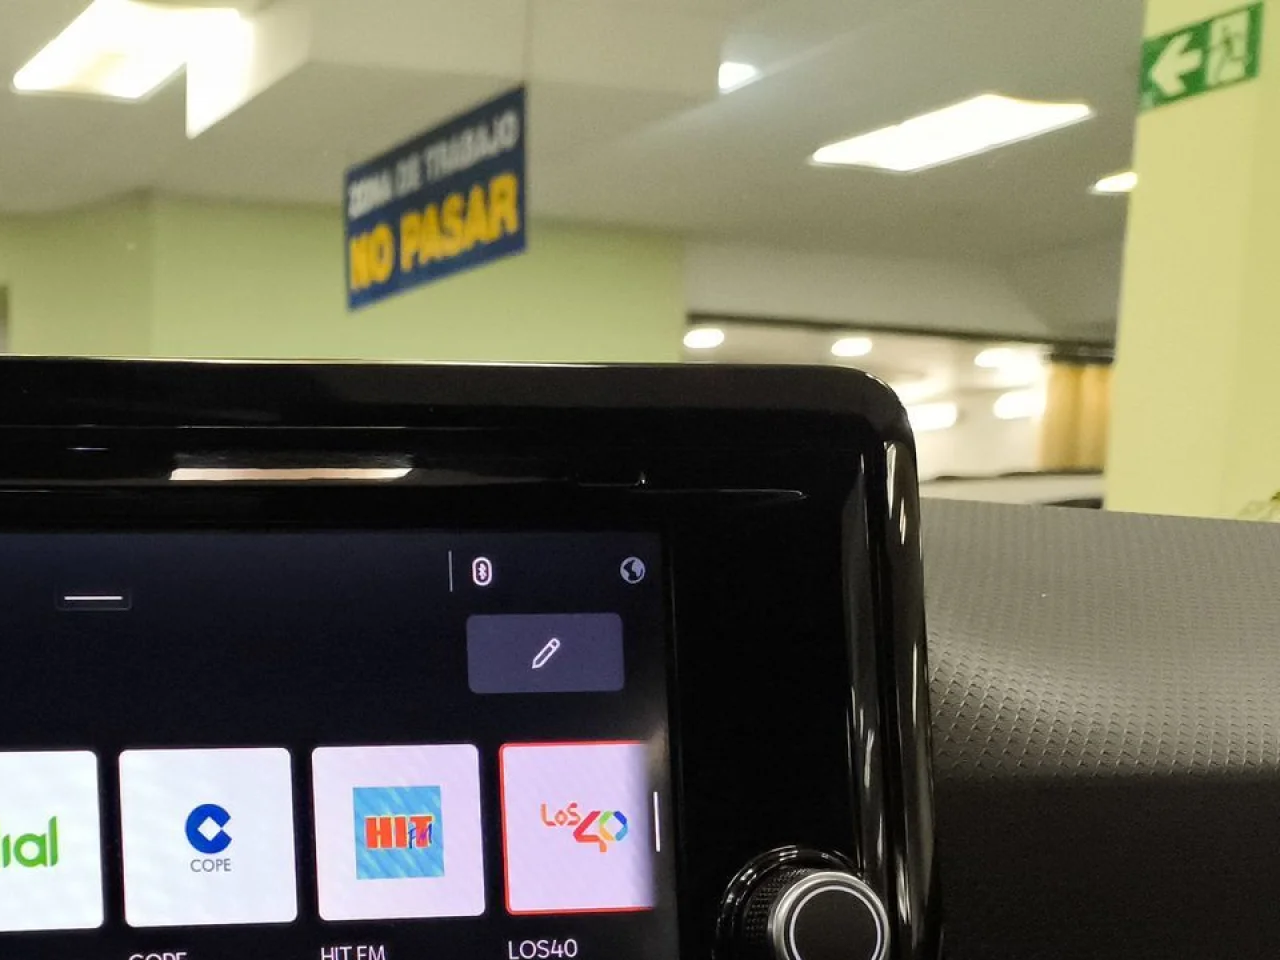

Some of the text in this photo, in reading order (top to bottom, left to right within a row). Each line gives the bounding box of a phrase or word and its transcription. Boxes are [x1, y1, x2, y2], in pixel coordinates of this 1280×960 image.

[349, 171, 518, 291] NO PASAR
[365, 814, 435, 851] HIT
[189, 858, 233, 873] COPE
[508, 938, 579, 960] LOS40
